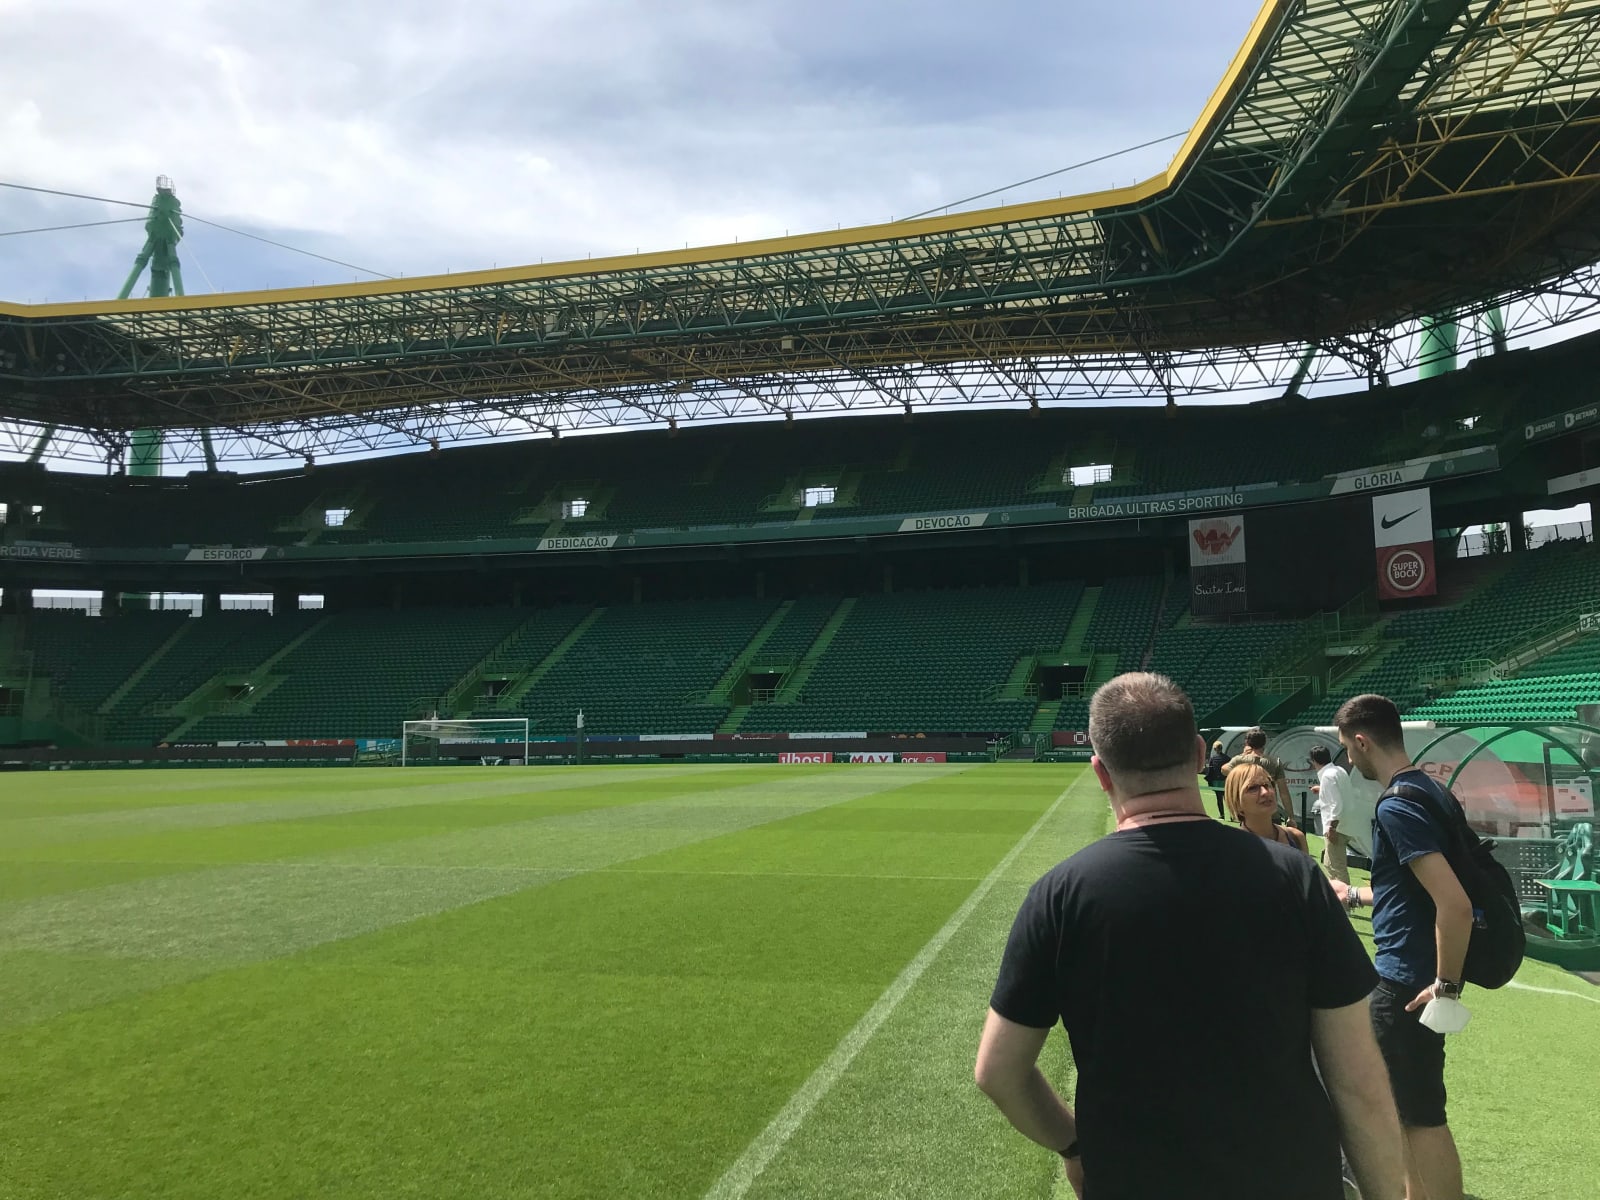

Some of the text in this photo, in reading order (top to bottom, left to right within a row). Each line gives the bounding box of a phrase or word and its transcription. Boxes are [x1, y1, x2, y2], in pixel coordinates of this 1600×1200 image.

[1354, 471, 1403, 489] GLÓRIA
[1068, 493, 1244, 519] BRIGADA ULTRAS SPORTING
[41, 548, 81, 559] VERDE
[1392, 561, 1419, 571] SUPER
[1394, 569, 1418, 579] BOCK
